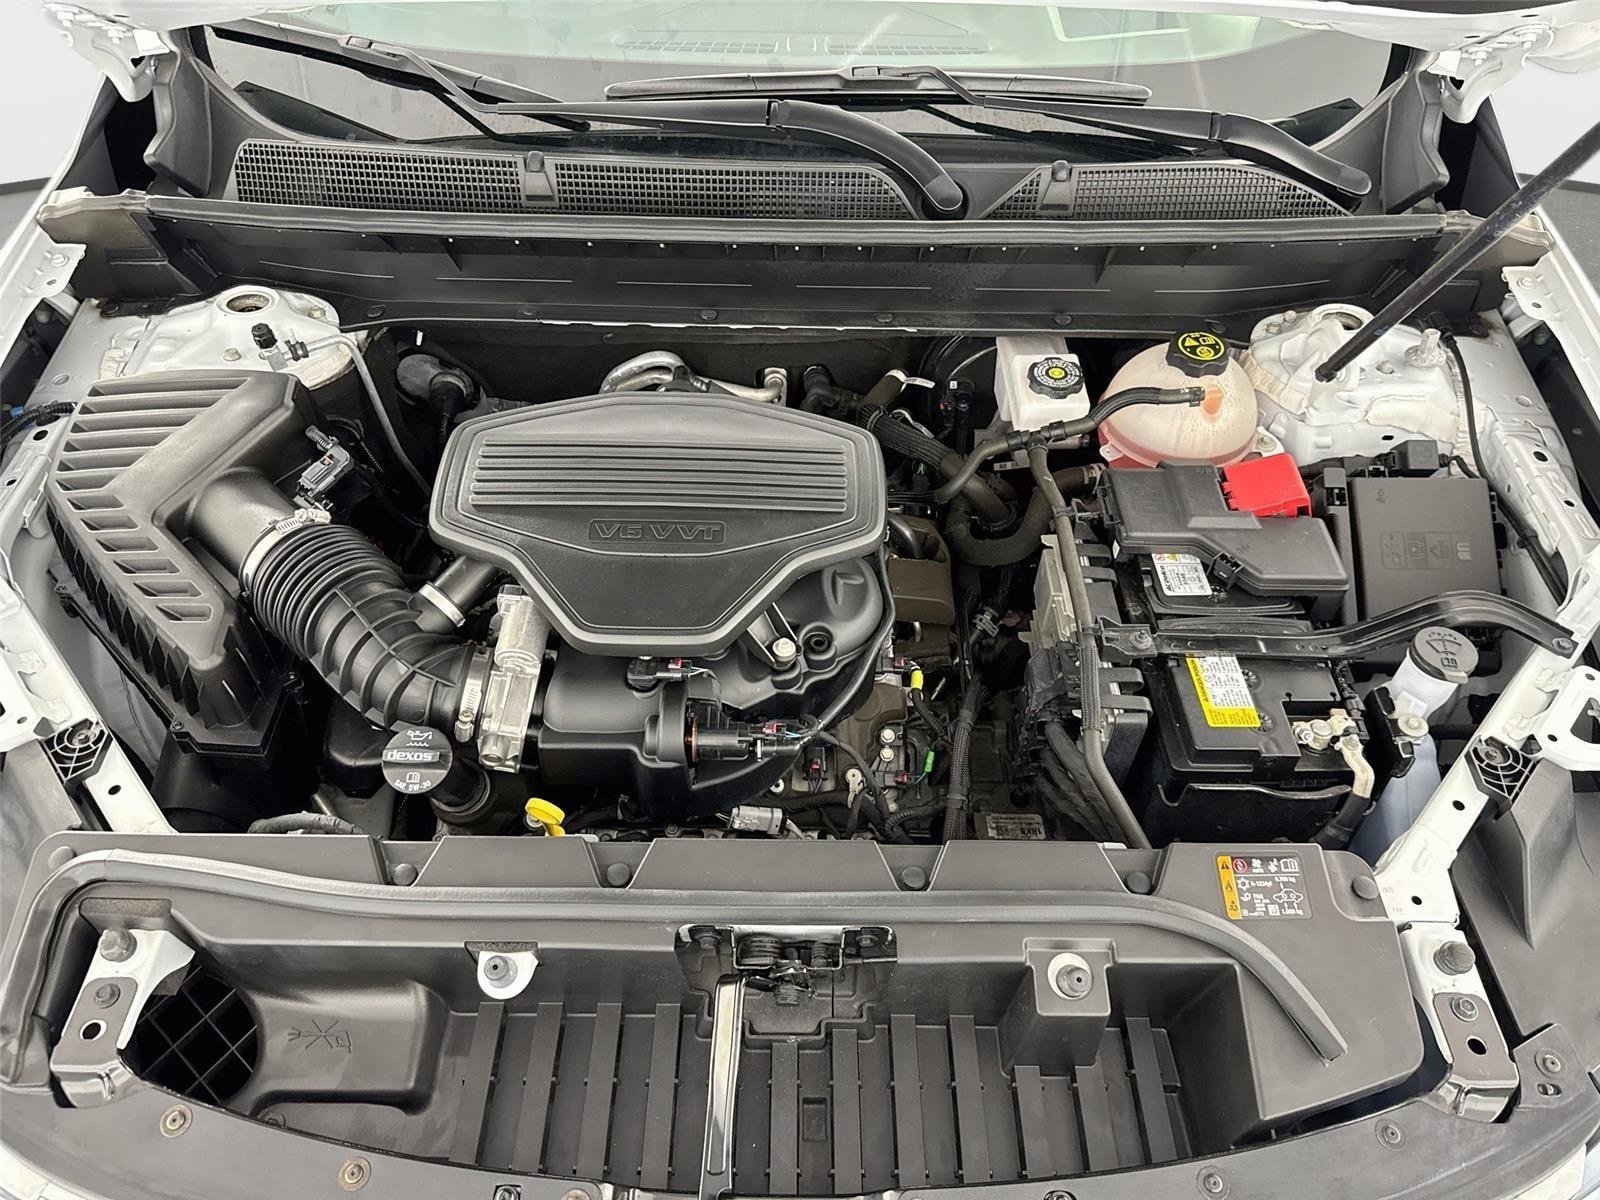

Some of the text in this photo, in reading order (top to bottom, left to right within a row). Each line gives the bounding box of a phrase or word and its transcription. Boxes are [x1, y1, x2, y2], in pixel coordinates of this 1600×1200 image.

[594, 522, 720, 540] V6 VVT
[386, 749, 435, 761] dexos
[408, 780, 432, 791] 5W-30
